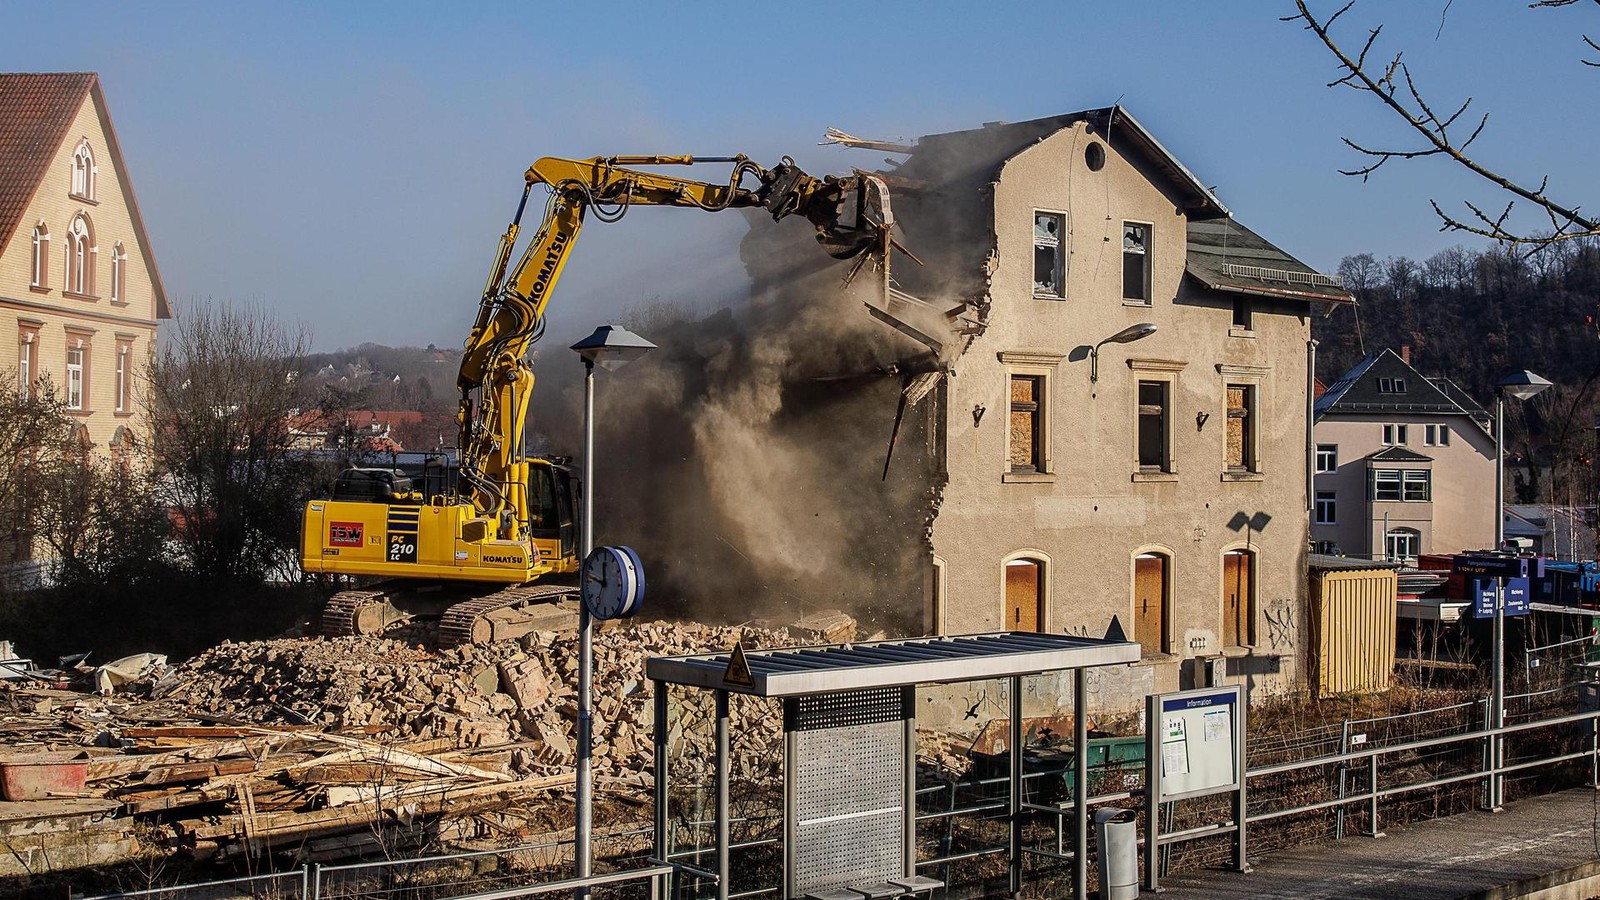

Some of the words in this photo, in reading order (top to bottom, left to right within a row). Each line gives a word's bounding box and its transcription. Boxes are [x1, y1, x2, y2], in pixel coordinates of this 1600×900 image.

[527, 231, 567, 305] KOMATSU
[391, 535, 404, 543] PC
[390, 544, 415, 554] 210
[483, 555, 522, 564] KOMATSU
[1186, 698, 1212, 708] Information
